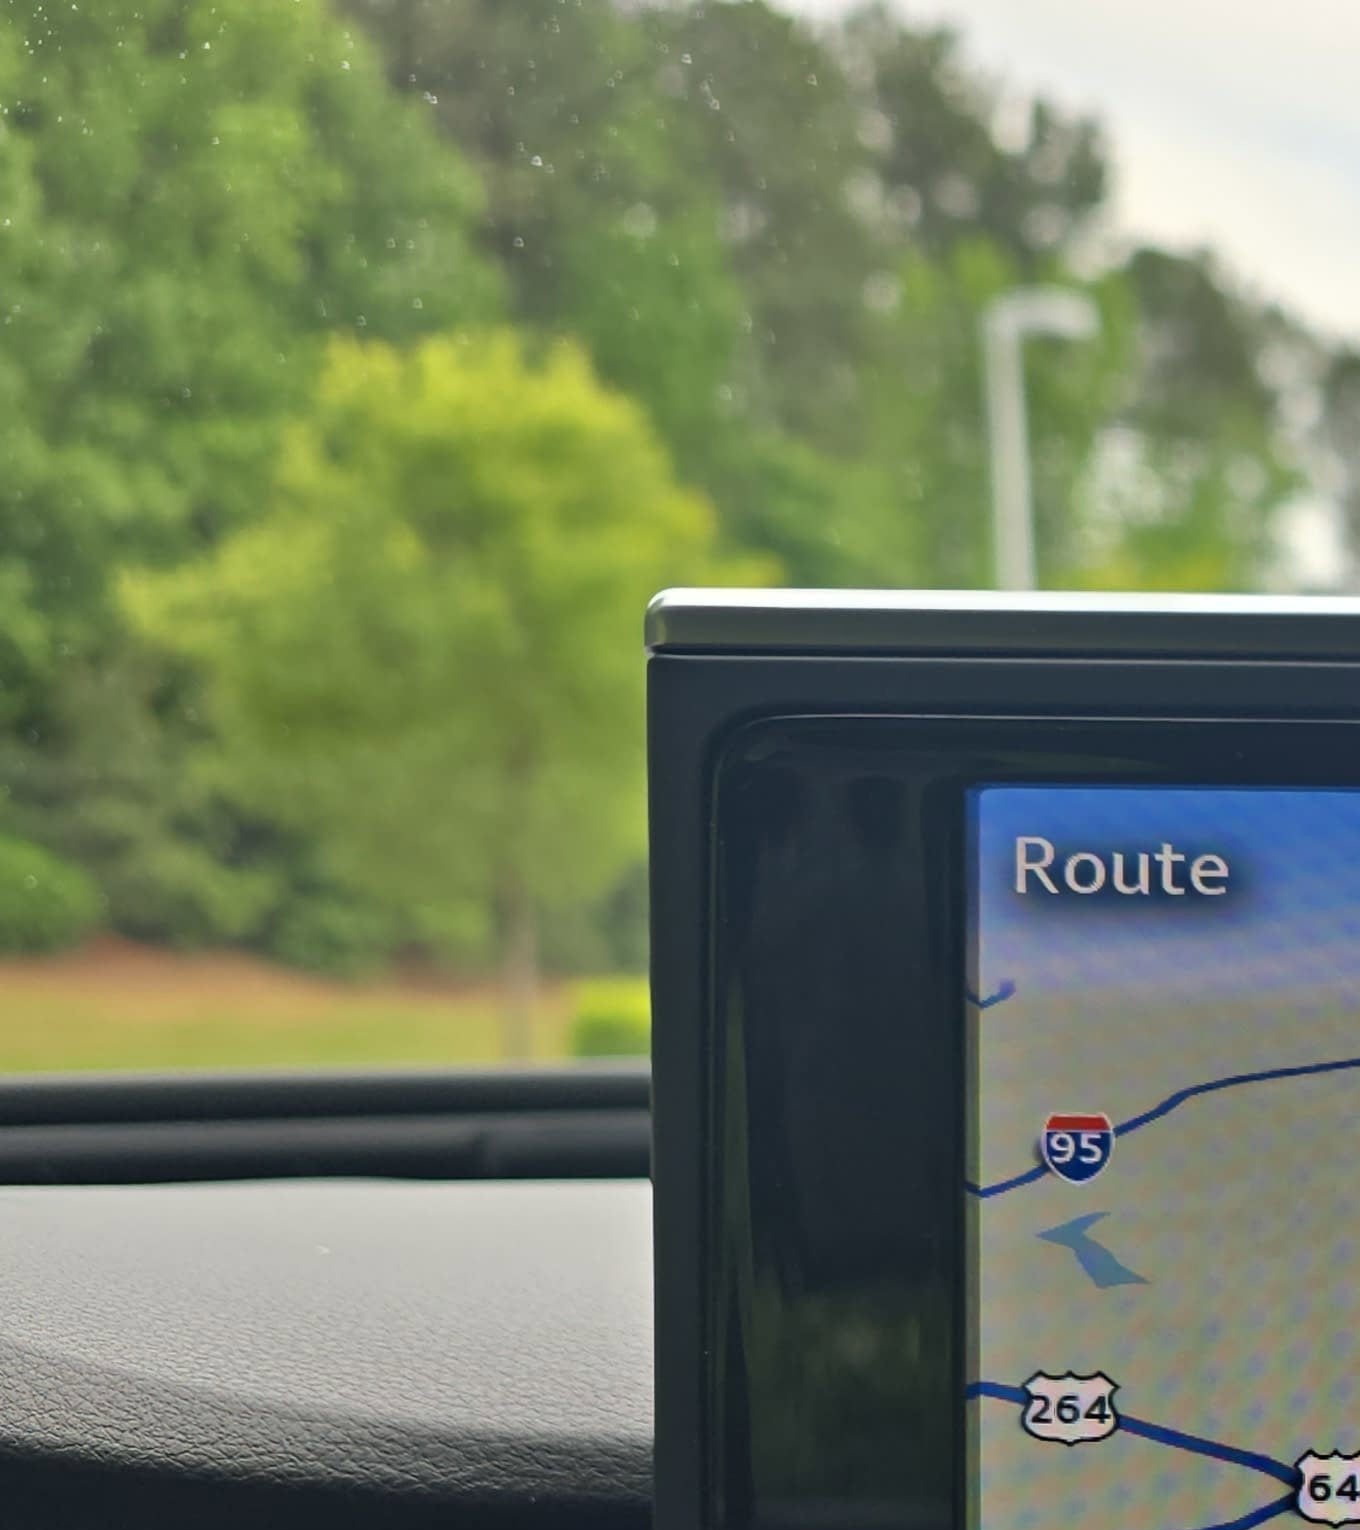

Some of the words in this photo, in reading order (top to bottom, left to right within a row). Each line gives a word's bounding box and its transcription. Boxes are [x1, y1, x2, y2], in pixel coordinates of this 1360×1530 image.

[1013, 836, 1230, 896] Route
[1049, 1133, 1104, 1163] 95
[1031, 1396, 1112, 1424] 264
[1308, 1474, 1360, 1501] 64
